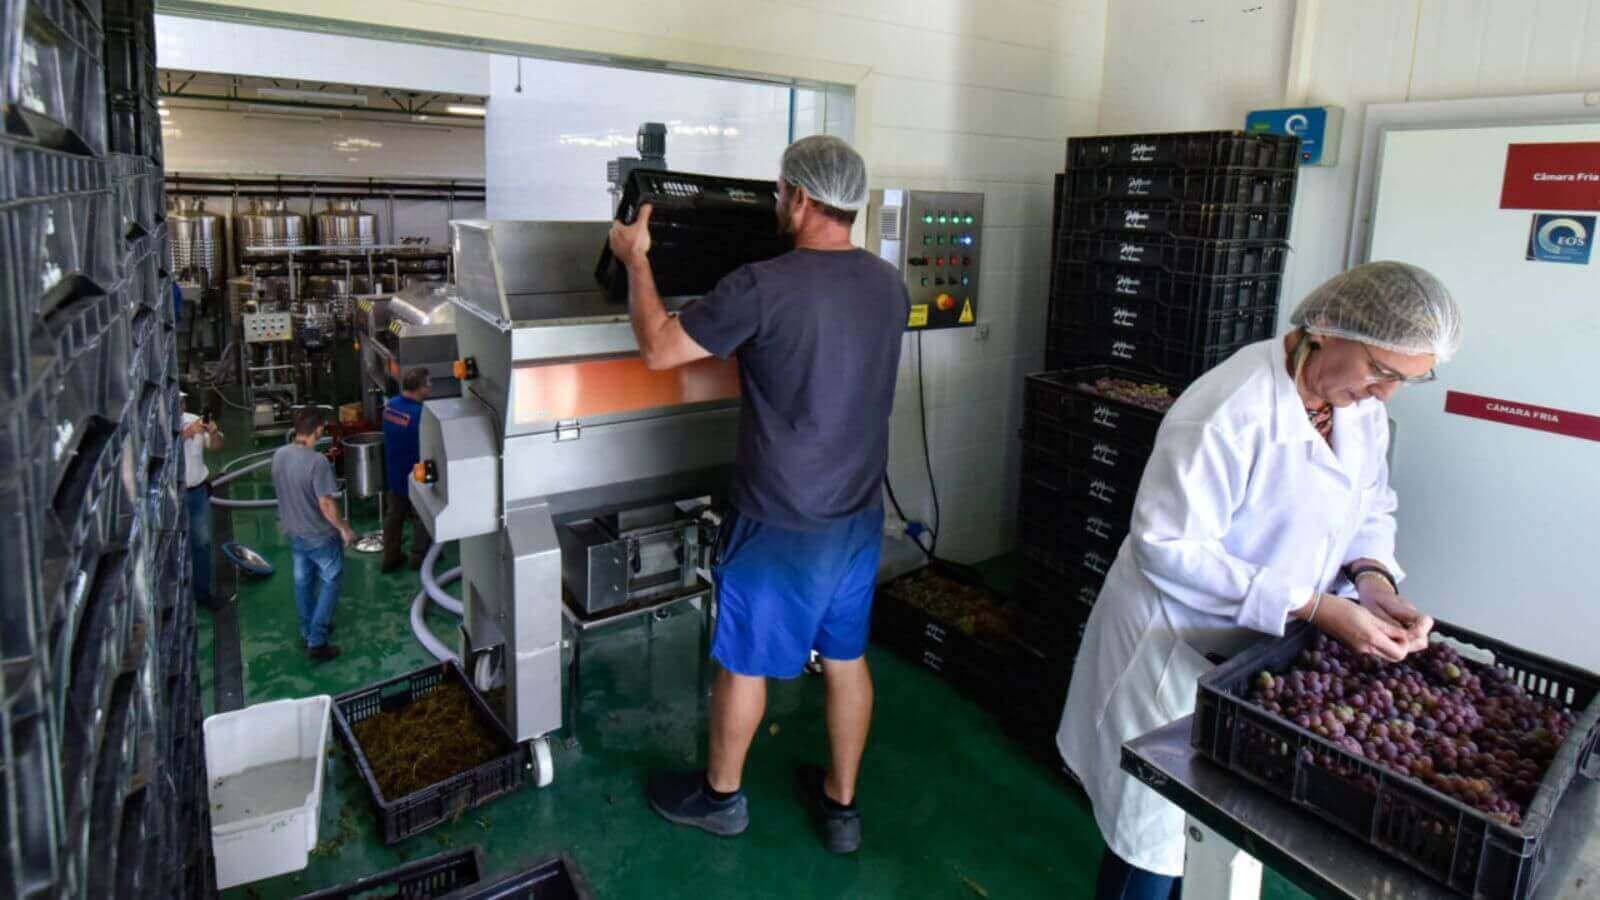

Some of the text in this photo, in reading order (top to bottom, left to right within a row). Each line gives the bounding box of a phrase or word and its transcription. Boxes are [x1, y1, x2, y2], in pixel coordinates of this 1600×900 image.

[1576, 172, 1600, 181] Fria
[1485, 402, 1560, 423] CÂMARA FRIA
